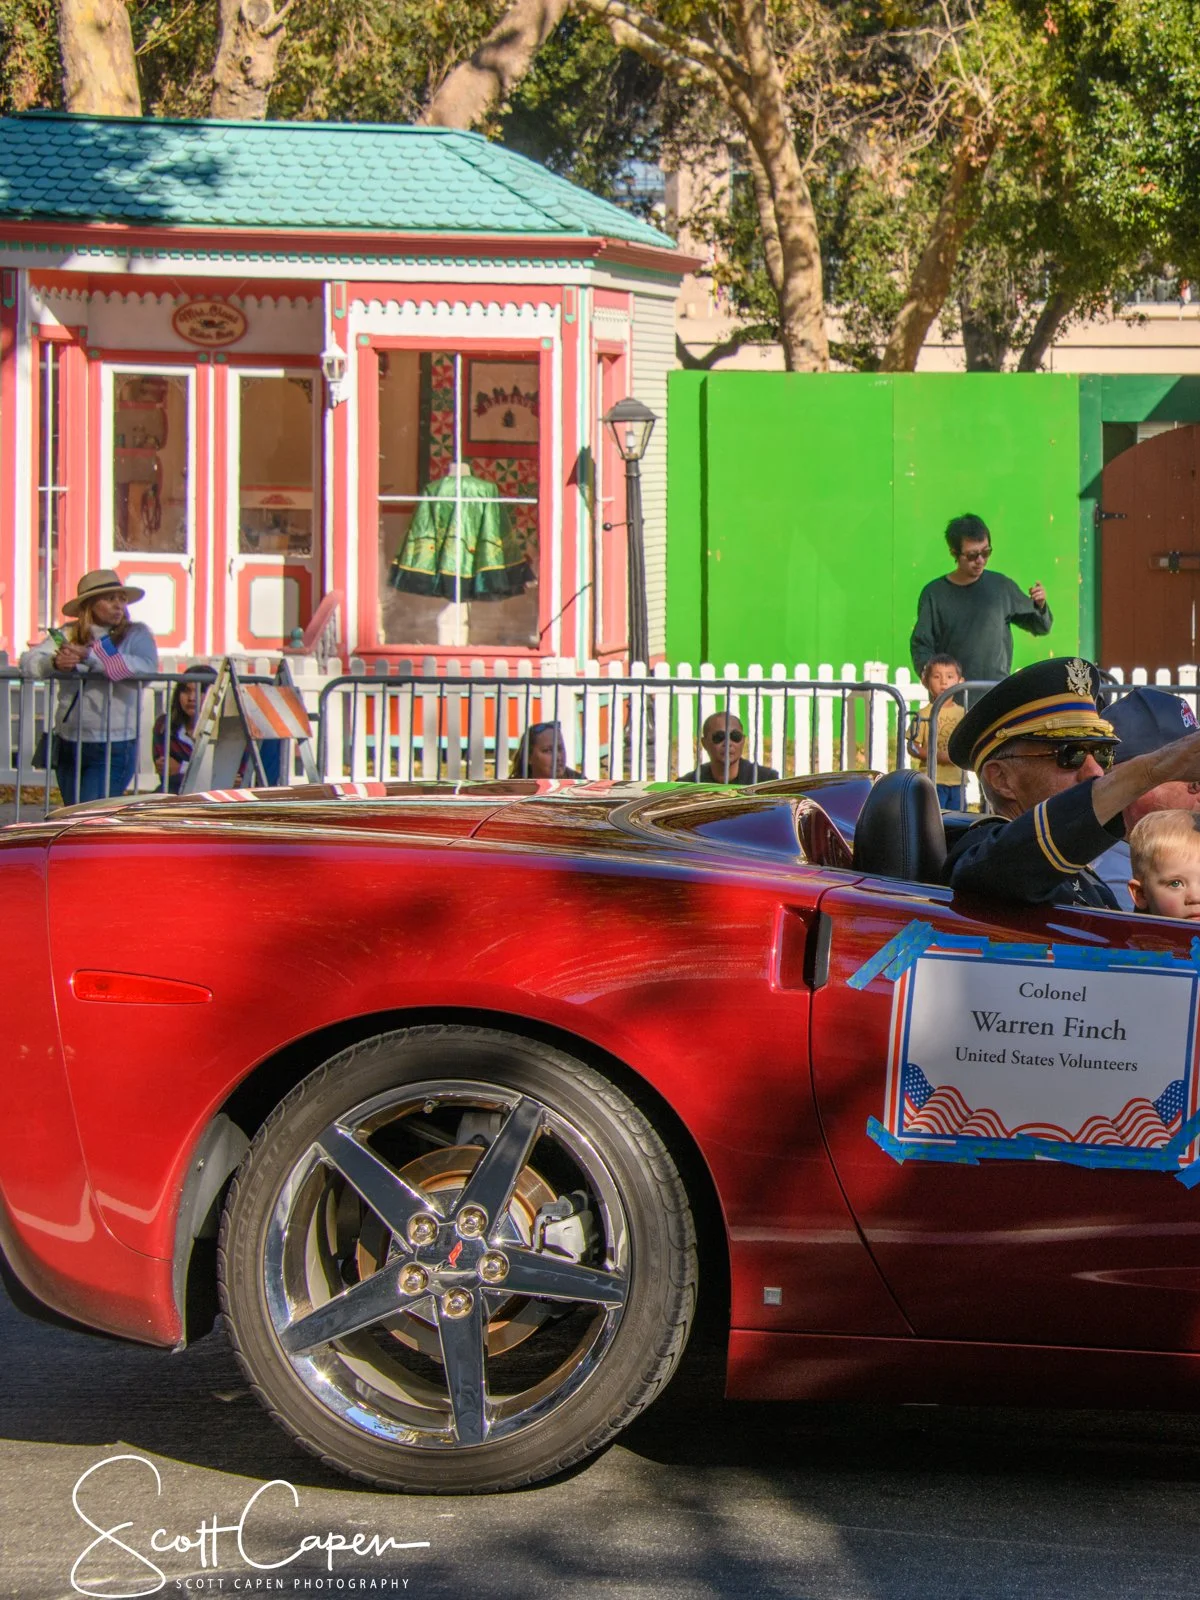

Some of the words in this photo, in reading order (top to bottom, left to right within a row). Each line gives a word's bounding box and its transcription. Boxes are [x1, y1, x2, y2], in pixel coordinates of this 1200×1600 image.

[1018, 981, 1088, 1003] Colonel
[970, 1010, 1055, 1036] Warren
[1063, 1016, 1128, 1042] Finch
[955, 1046, 1007, 1065] United
[1011, 1050, 1055, 1068] States
[1059, 1053, 1139, 1073] Volunteers
